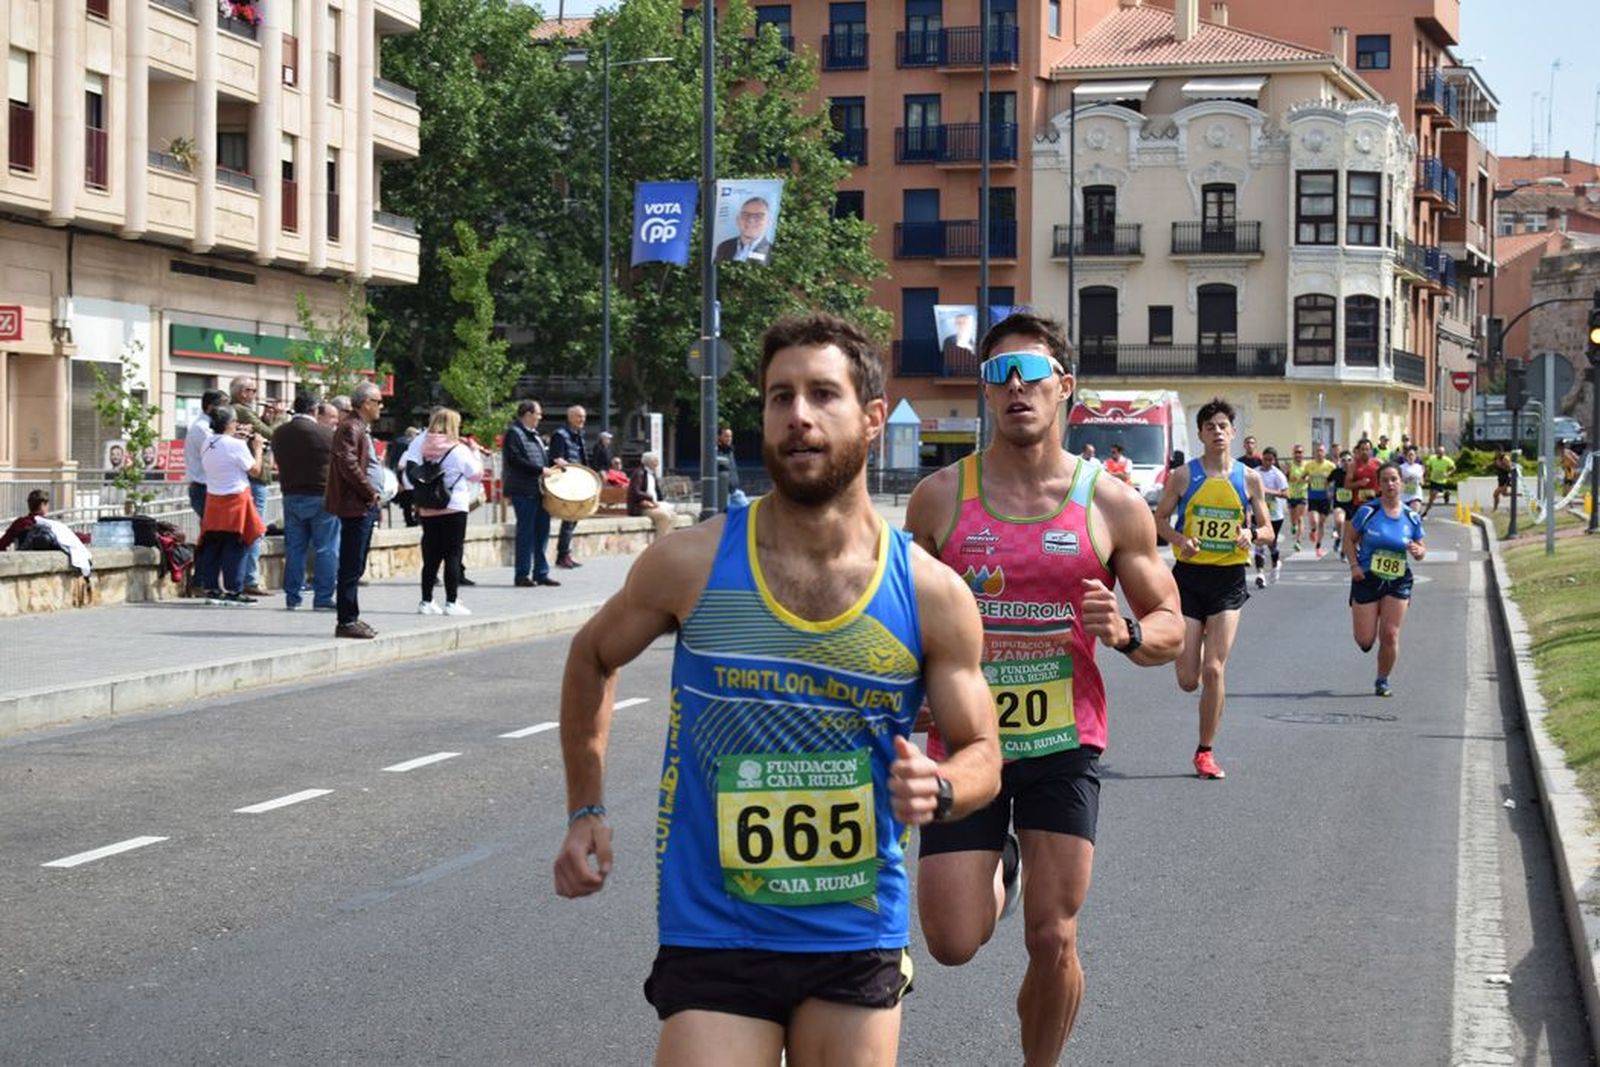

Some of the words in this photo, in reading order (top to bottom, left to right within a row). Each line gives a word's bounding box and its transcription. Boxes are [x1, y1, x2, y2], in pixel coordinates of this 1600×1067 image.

[644, 202, 682, 215] VOTA
[1197, 520, 1231, 539] 182
[1376, 558, 1400, 573] 198
[976, 600, 1076, 619] BERDROLA
[991, 646, 1066, 662] ZAMORA
[1028, 670, 1060, 682] RURAL
[996, 689, 1048, 728] 20
[1034, 731, 1072, 749] RURAL
[767, 758, 858, 773] FUNDACION
[808, 773, 857, 787] RURAL
[737, 802, 862, 864] 665
[815, 871, 869, 890] RURAL
